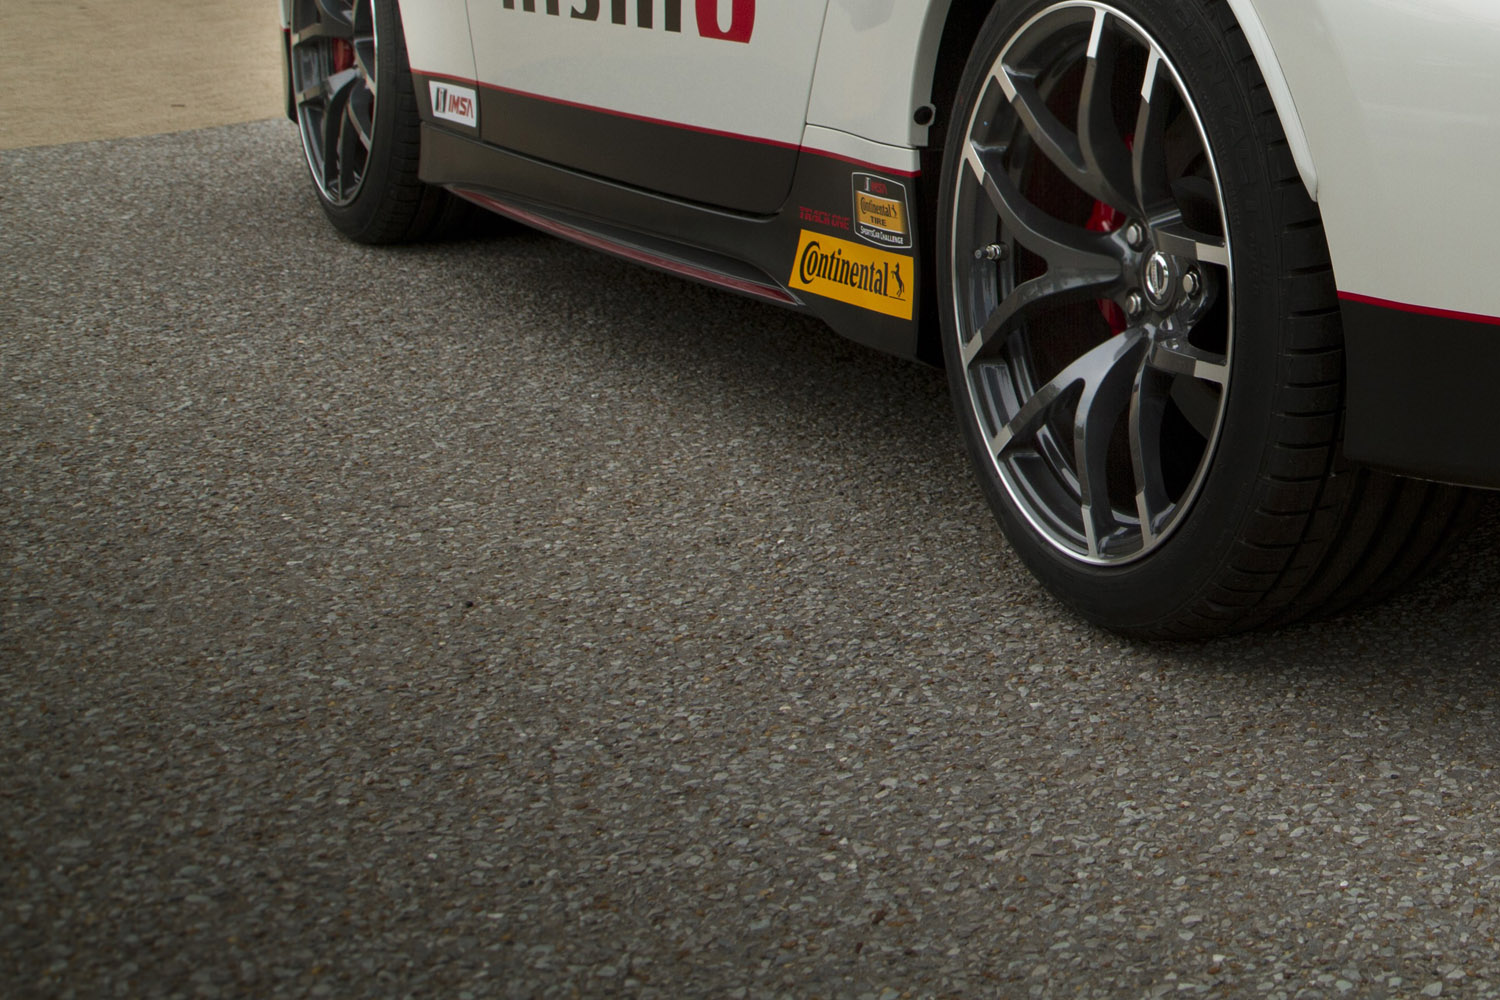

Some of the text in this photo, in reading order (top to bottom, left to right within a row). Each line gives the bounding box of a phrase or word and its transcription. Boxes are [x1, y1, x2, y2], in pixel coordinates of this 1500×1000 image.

[448, 94, 474, 119] IMSA
[870, 215, 887, 227] TIRE
[799, 241, 889, 297] Continental
